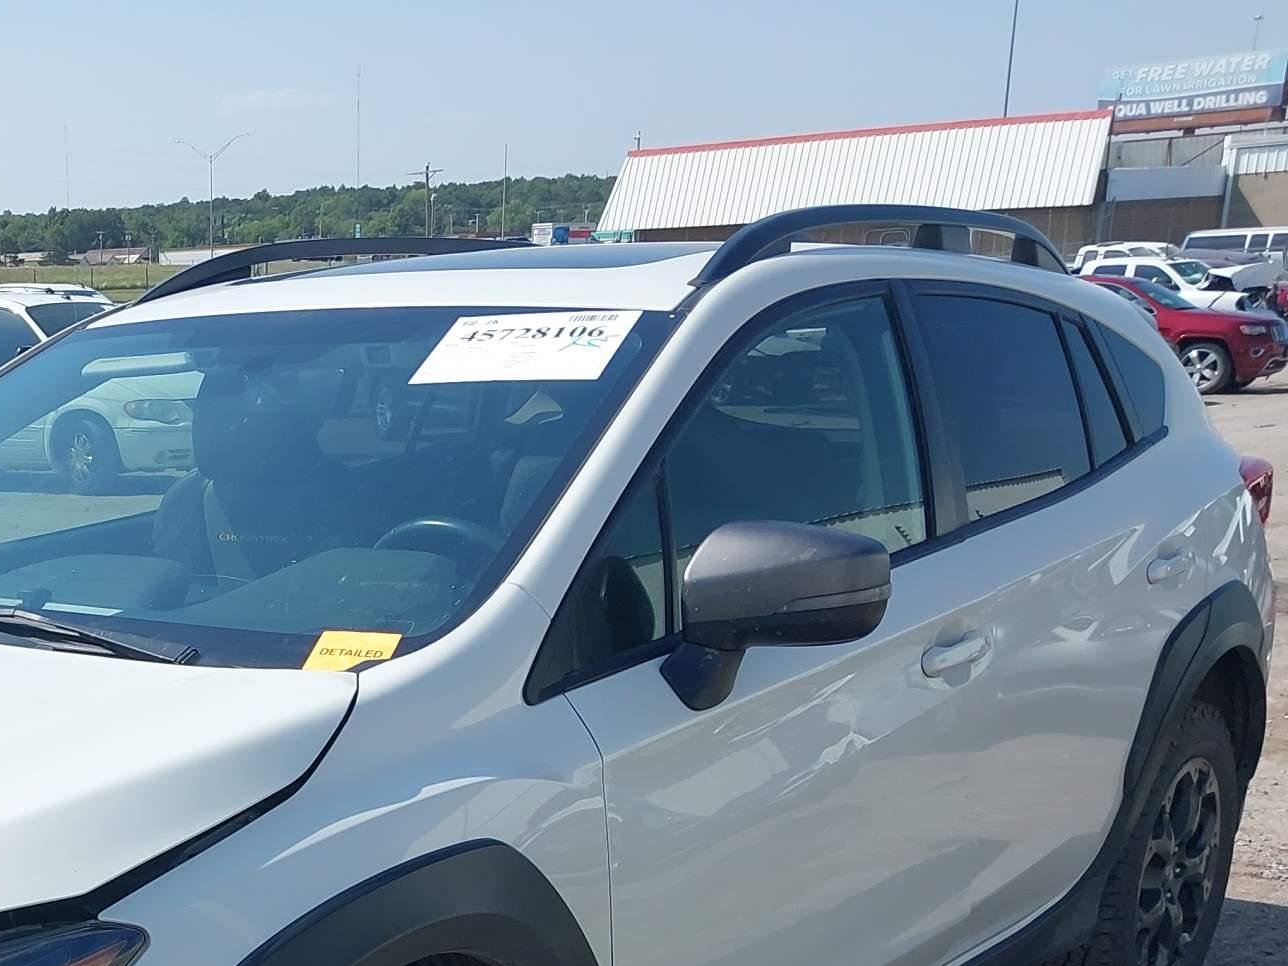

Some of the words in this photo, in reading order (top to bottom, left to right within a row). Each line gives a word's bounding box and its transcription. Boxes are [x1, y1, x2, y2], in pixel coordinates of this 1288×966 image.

[1113, 69, 1133, 80] GET
[1135, 62, 1188, 83] FREE
[1192, 53, 1272, 77] WATER
[1120, 86, 1142, 97] FOR
[1145, 81, 1181, 94] LAWN
[1183, 73, 1257, 90] IRRIGATION
[1114, 102, 1146, 118] QUA
[1150, 99, 1190, 114] WELL
[1193, 90, 1268, 111] DRILLING
[460, 325, 607, 342] 45728106
[319, 647, 384, 658] DETAILED
